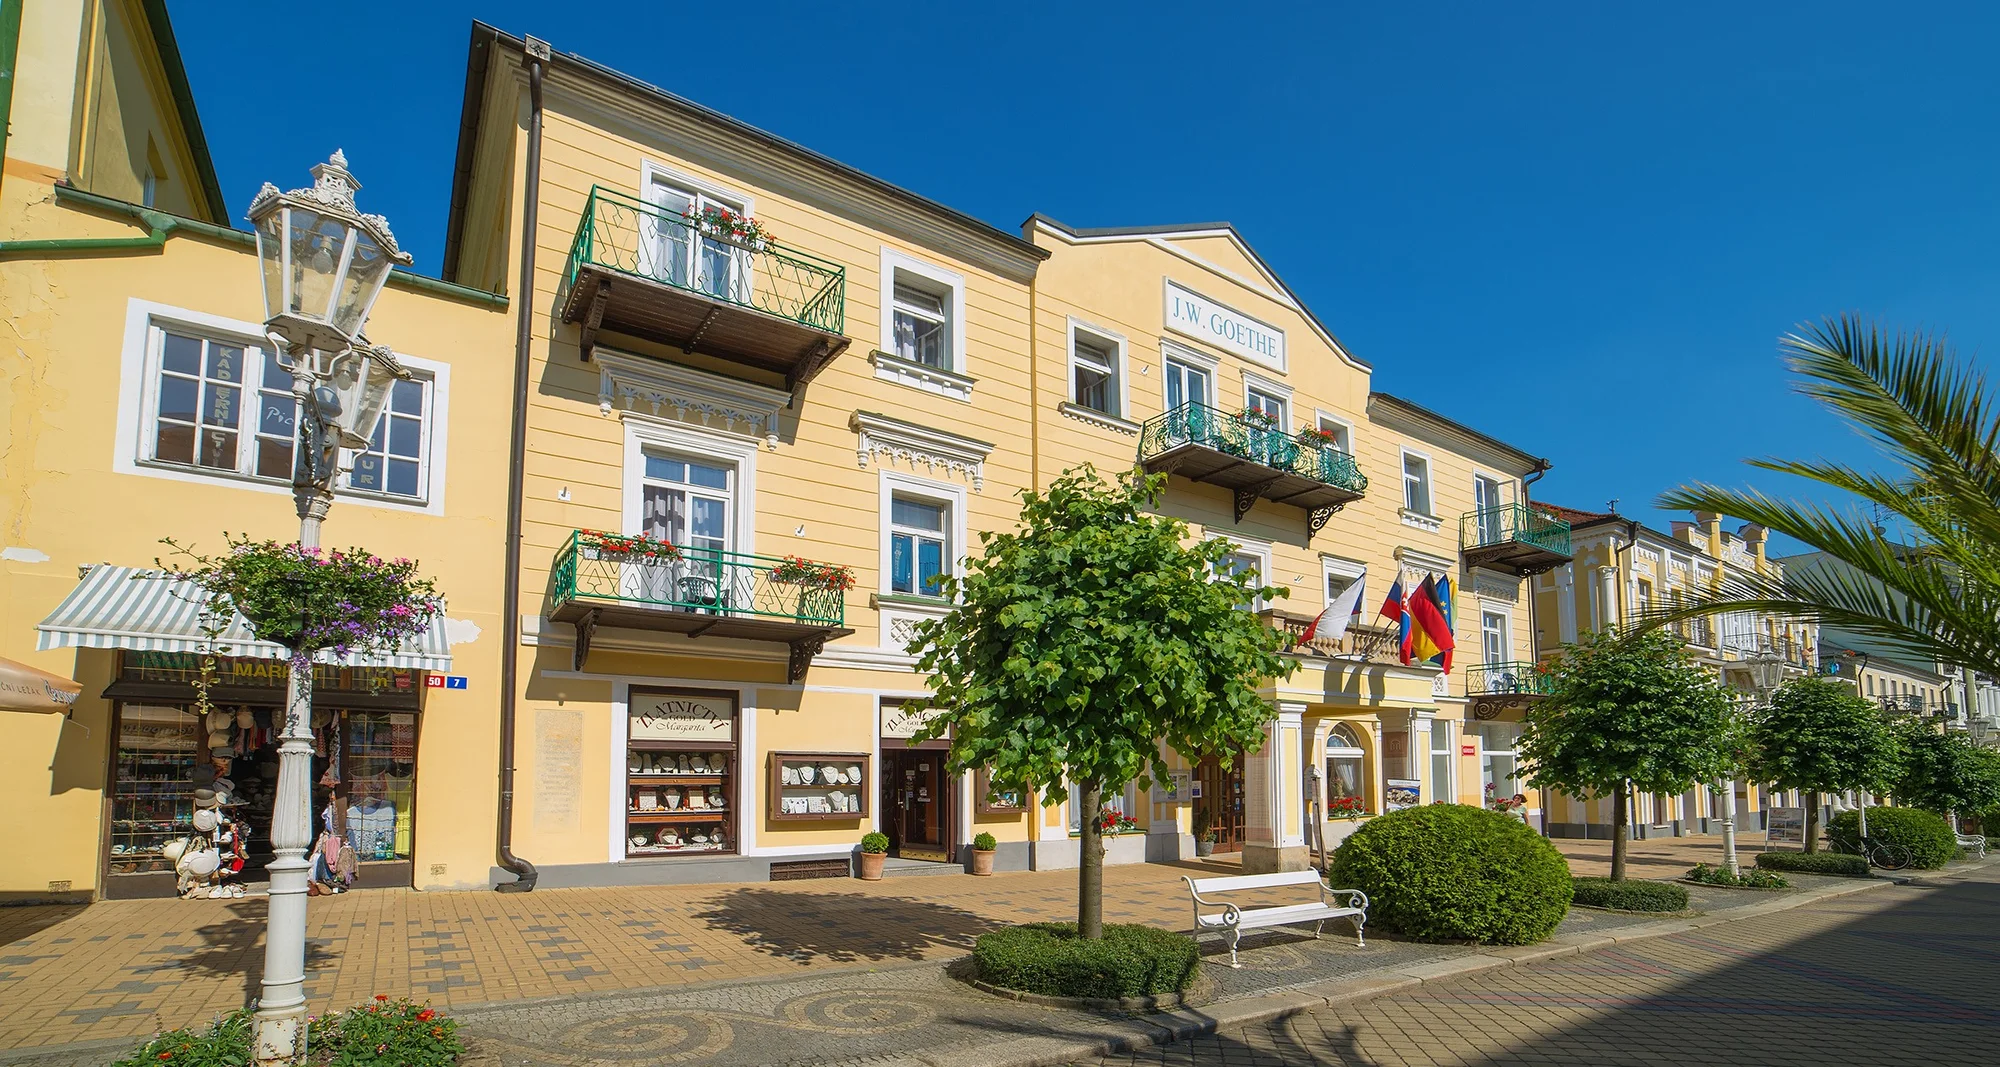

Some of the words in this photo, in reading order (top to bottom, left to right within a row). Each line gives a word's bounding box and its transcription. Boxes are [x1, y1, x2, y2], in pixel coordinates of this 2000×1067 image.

[1210, 313, 1277, 359] GOETHE
[428, 677, 441, 686] 50
[453, 679, 460, 687] 7
[636, 700, 729, 730] ZLATNICTVÍ
[669, 714, 696, 722] GOLD
[655, 721, 706, 734] Margarita
